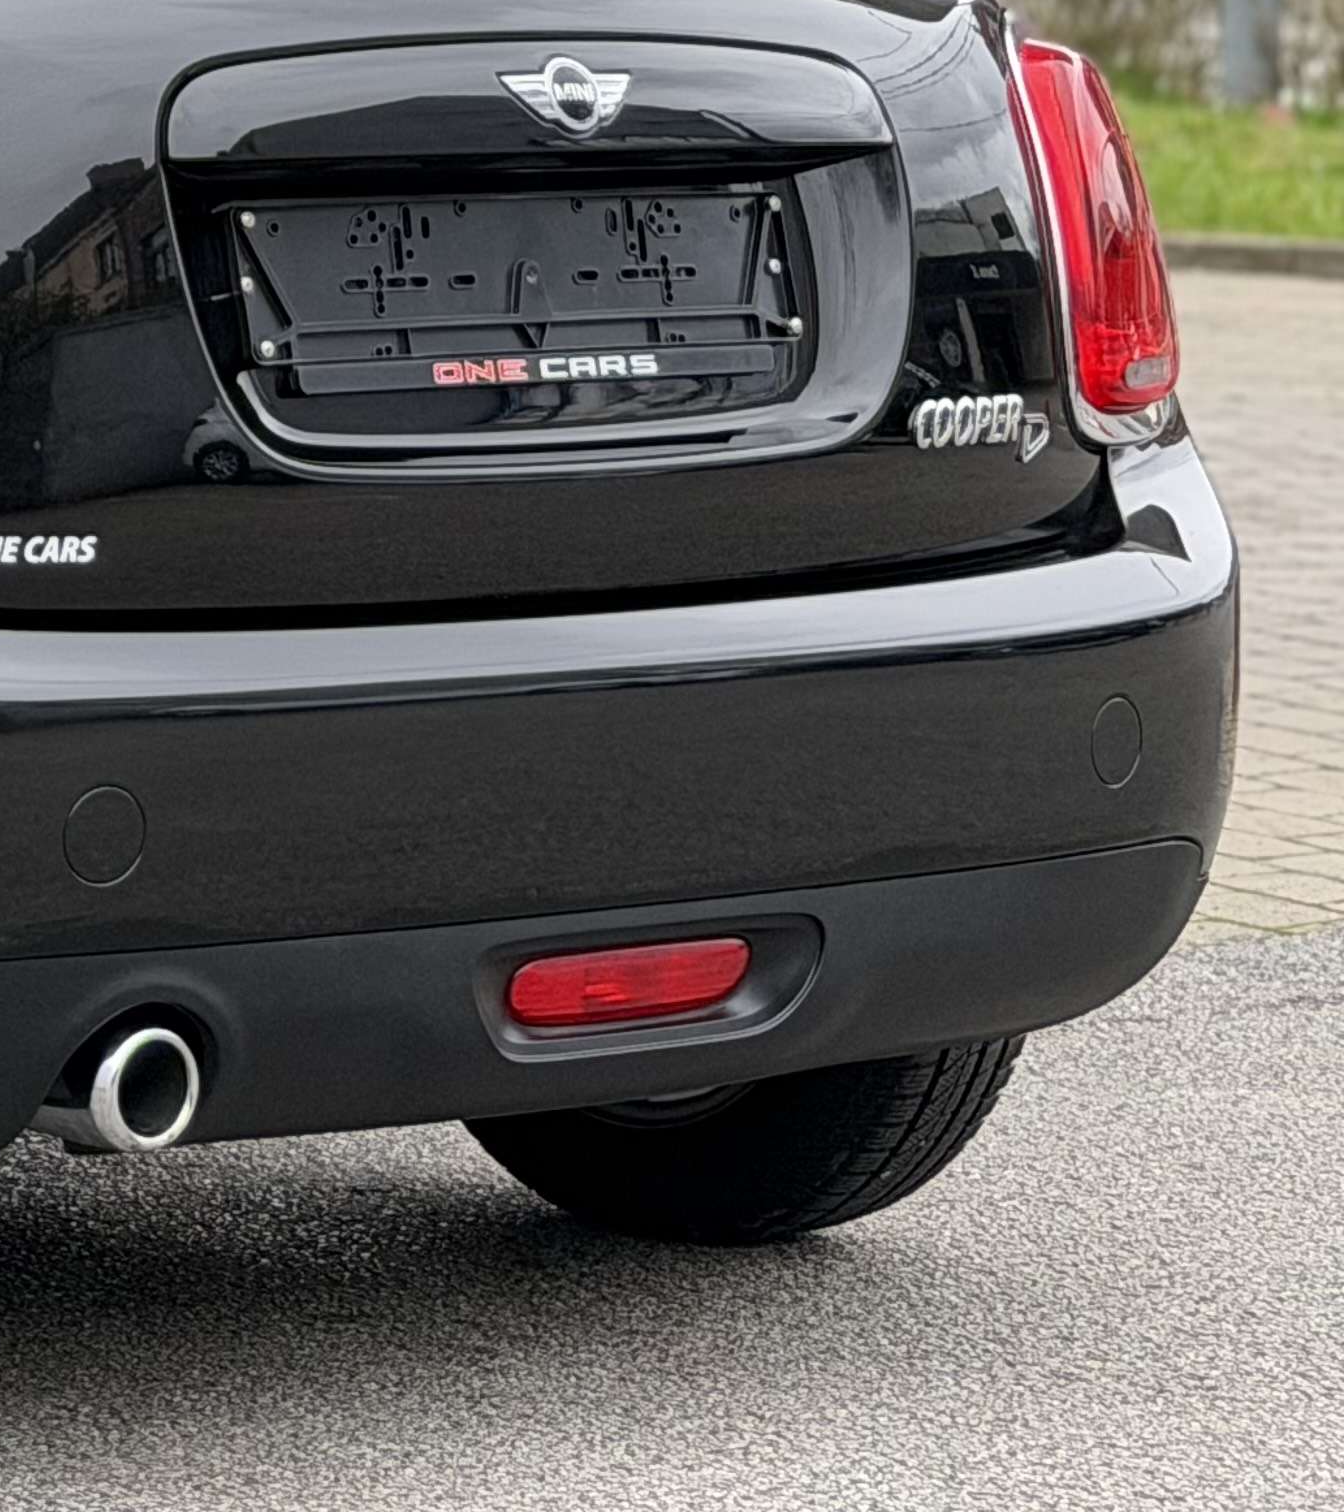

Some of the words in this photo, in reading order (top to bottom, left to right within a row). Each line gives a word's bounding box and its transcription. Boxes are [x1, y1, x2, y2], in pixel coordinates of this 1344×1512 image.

[553, 82, 596, 102] MINI
[432, 359, 529, 385] ONE
[539, 354, 658, 379] CARS
[915, 393, 1024, 450] COOPER
[23, 535, 98, 564] CARS
